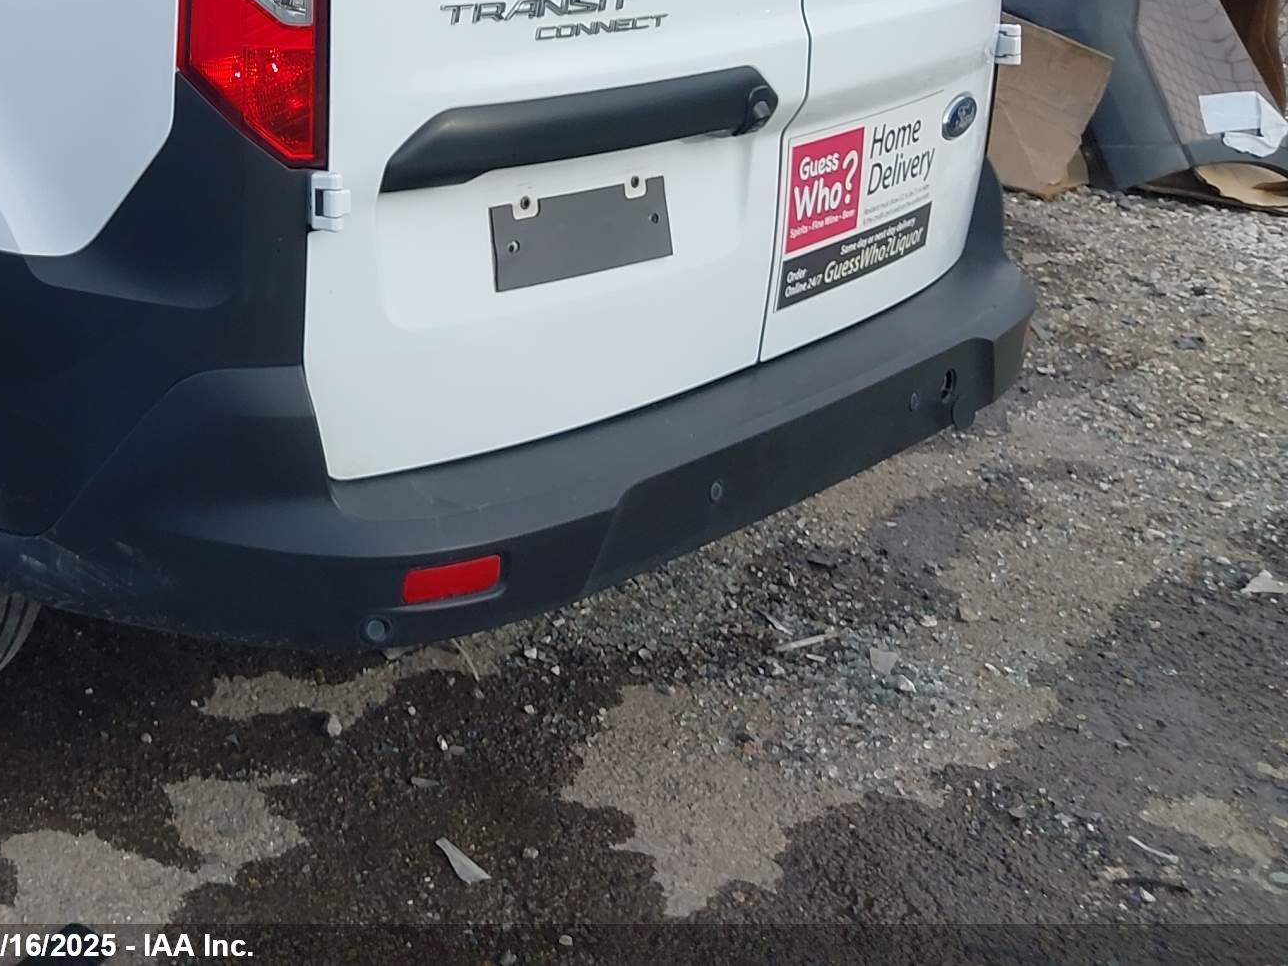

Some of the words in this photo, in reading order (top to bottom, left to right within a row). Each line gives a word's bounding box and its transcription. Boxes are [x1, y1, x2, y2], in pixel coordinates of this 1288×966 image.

[534, 13, 668, 41] CONNECT
[870, 119, 922, 160] Home
[799, 152, 840, 181] Guess
[867, 148, 936, 196] Delivery
[793, 150, 859, 222] Who?
[823, 226, 924, 284] GuessWho?Liquor
[784, 281, 807, 298] Online
[786, 268, 807, 284] Order
